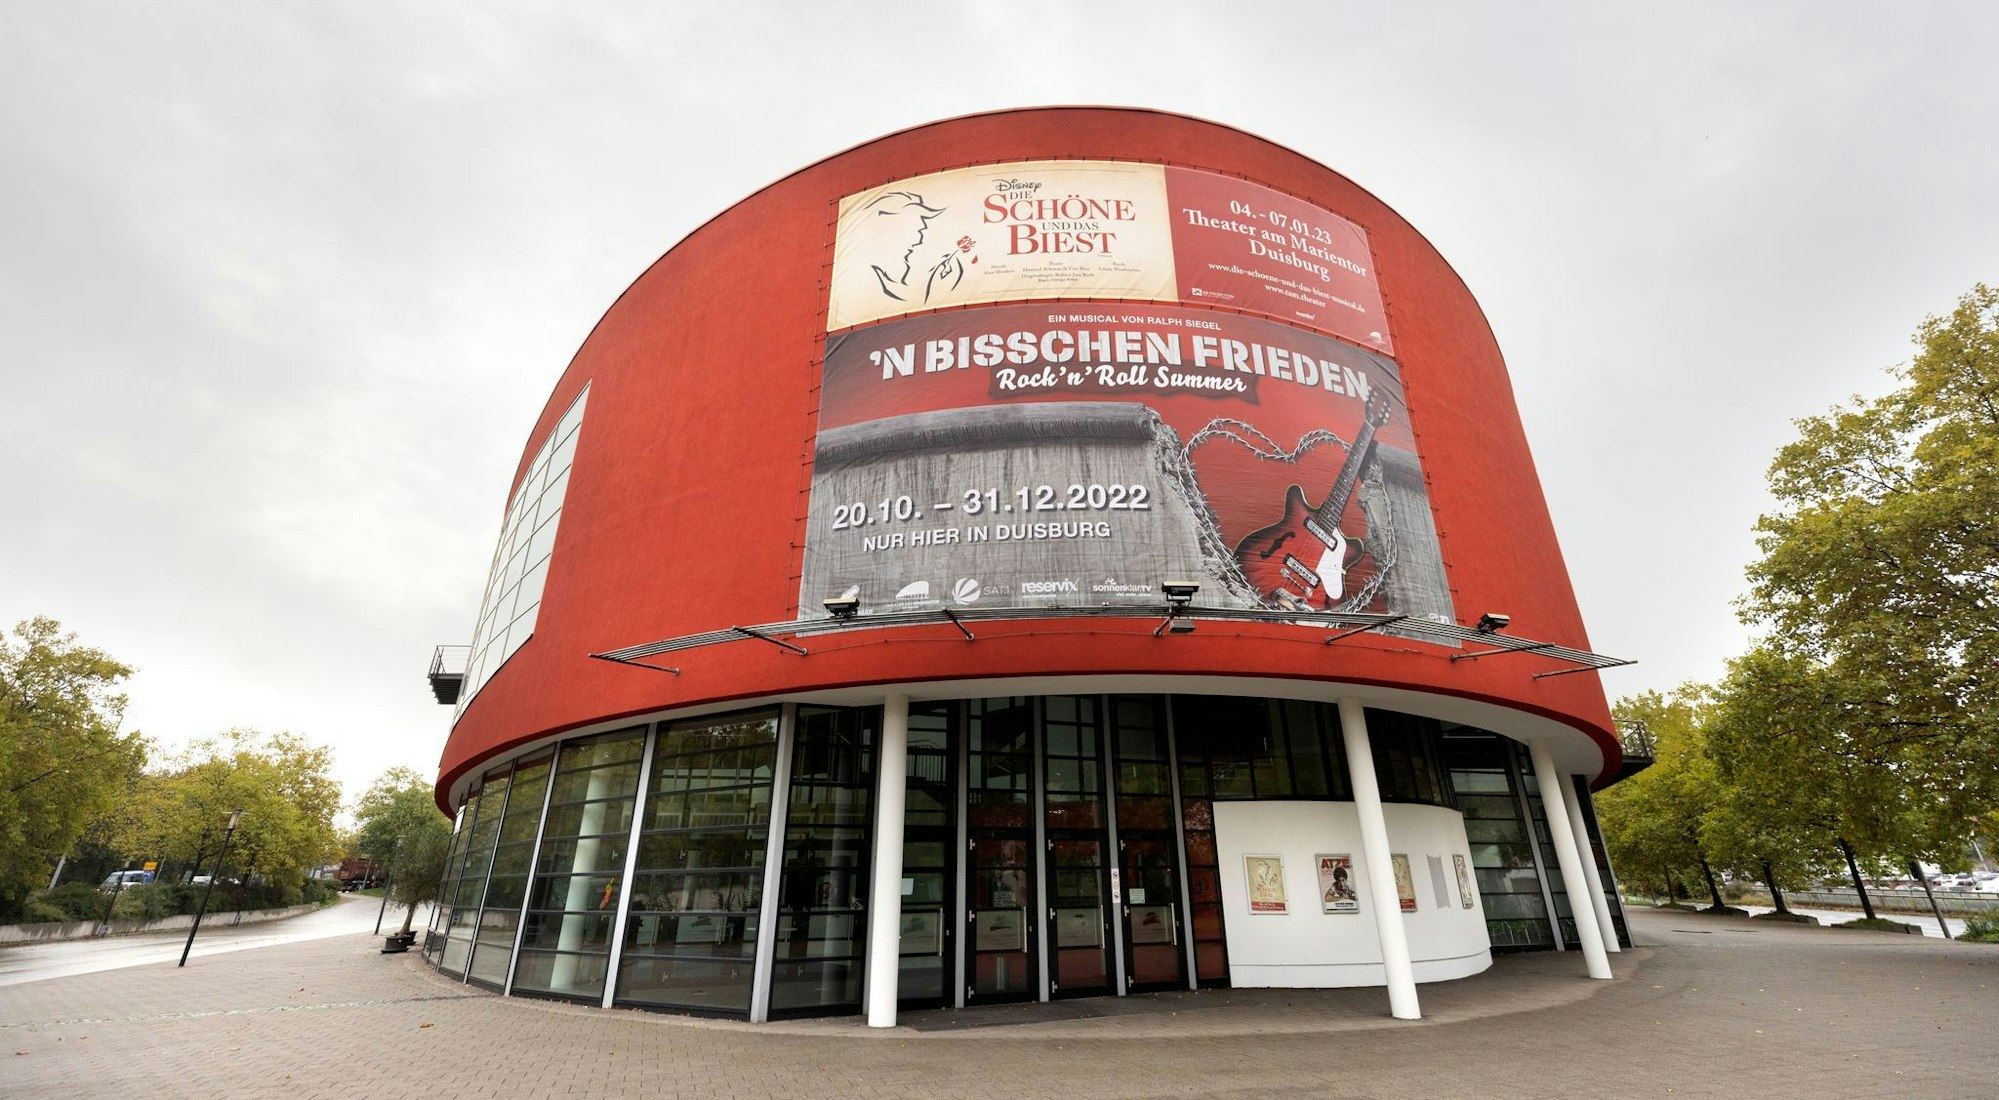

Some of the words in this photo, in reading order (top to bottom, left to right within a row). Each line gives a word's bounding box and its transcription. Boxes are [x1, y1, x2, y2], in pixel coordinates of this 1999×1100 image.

[992, 178, 1042, 193] Disney
[1009, 191, 1033, 200] DIE
[983, 193, 1136, 224] SCHÖNE
[1007, 223, 1117, 256] BIEST
[1042, 222, 1071, 231] UND
[1074, 222, 1099, 231] DAS
[1182, 208, 1256, 236] Theater
[1261, 229, 1287, 245] am
[1289, 233, 1367, 277] Marientor
[1248, 239, 1331, 282] Duisburg
[1264, 284, 1326, 308] www.tam.theater
[1048, 315, 1067, 323] EIN
[1069, 315, 1119, 323] MUSICAL
[1121, 316, 1144, 324] VON
[1147, 317, 1183, 326] RALPH
[1185, 320, 1222, 331] SIEGEL
[925, 330, 1182, 373] BISSCHEN
[1192, 335, 1370, 402] FRIEDEN
[1153, 365, 1248, 392] Summer
[832, 495, 922, 530] 20.10.
[963, 484, 1149, 514] 31.12.2022
[863, 533, 905, 552] NUR
[911, 528, 960, 547] HIER
[967, 526, 988, 542] IN
[996, 521, 1111, 540] DUISBURG
[1021, 578, 1080, 597] reservix
